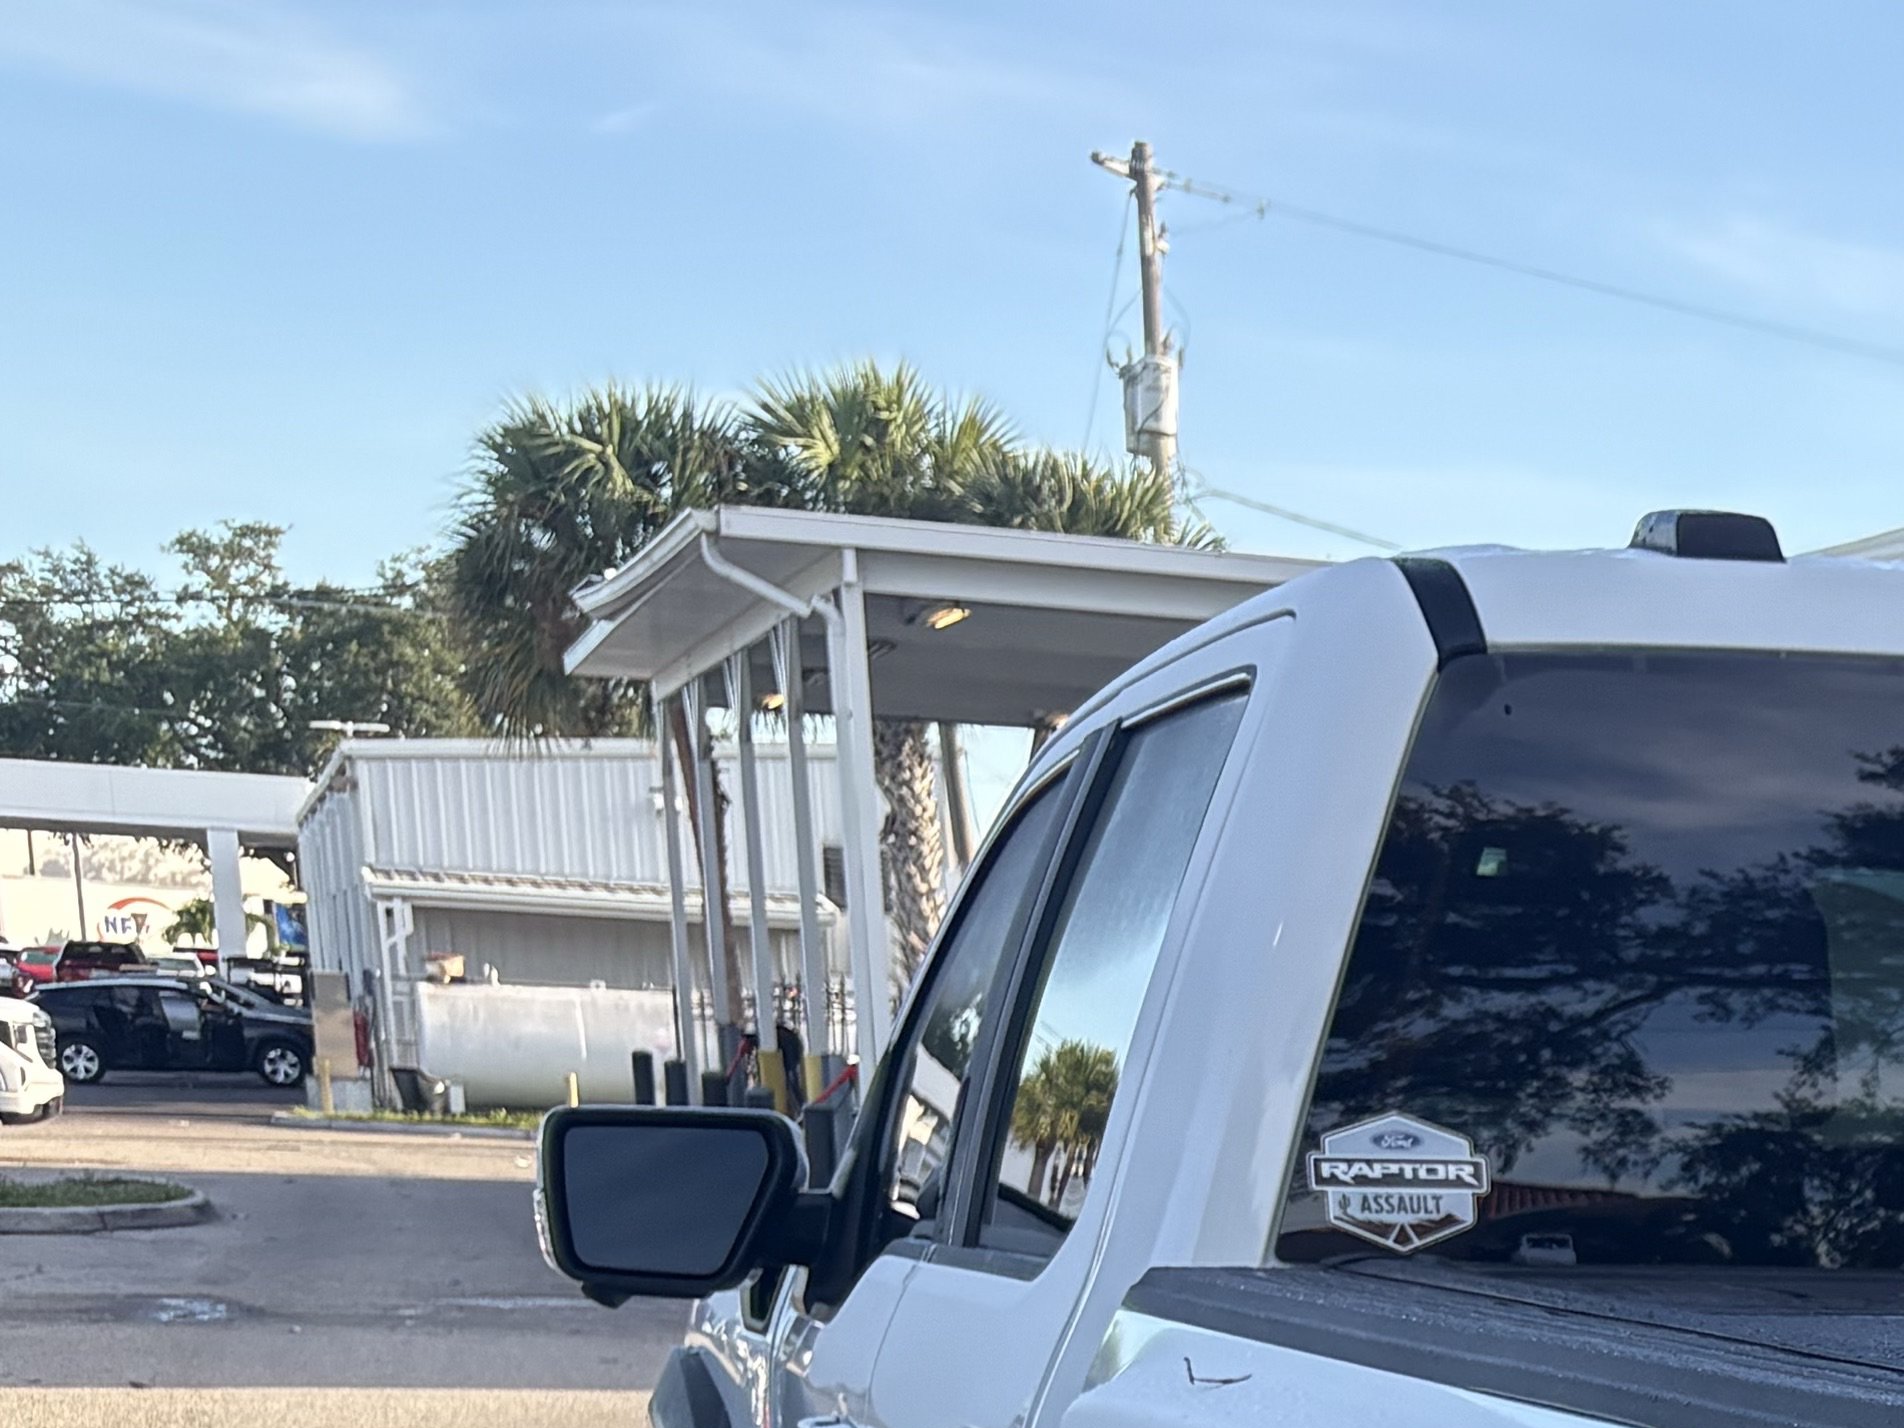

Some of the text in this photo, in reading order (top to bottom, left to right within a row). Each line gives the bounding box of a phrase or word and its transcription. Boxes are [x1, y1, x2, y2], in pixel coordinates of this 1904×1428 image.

[1380, 1135, 1414, 1148] Ford
[1320, 1161, 1479, 1186] RAPTOR
[1360, 1193, 1443, 1215] ASSAULT
